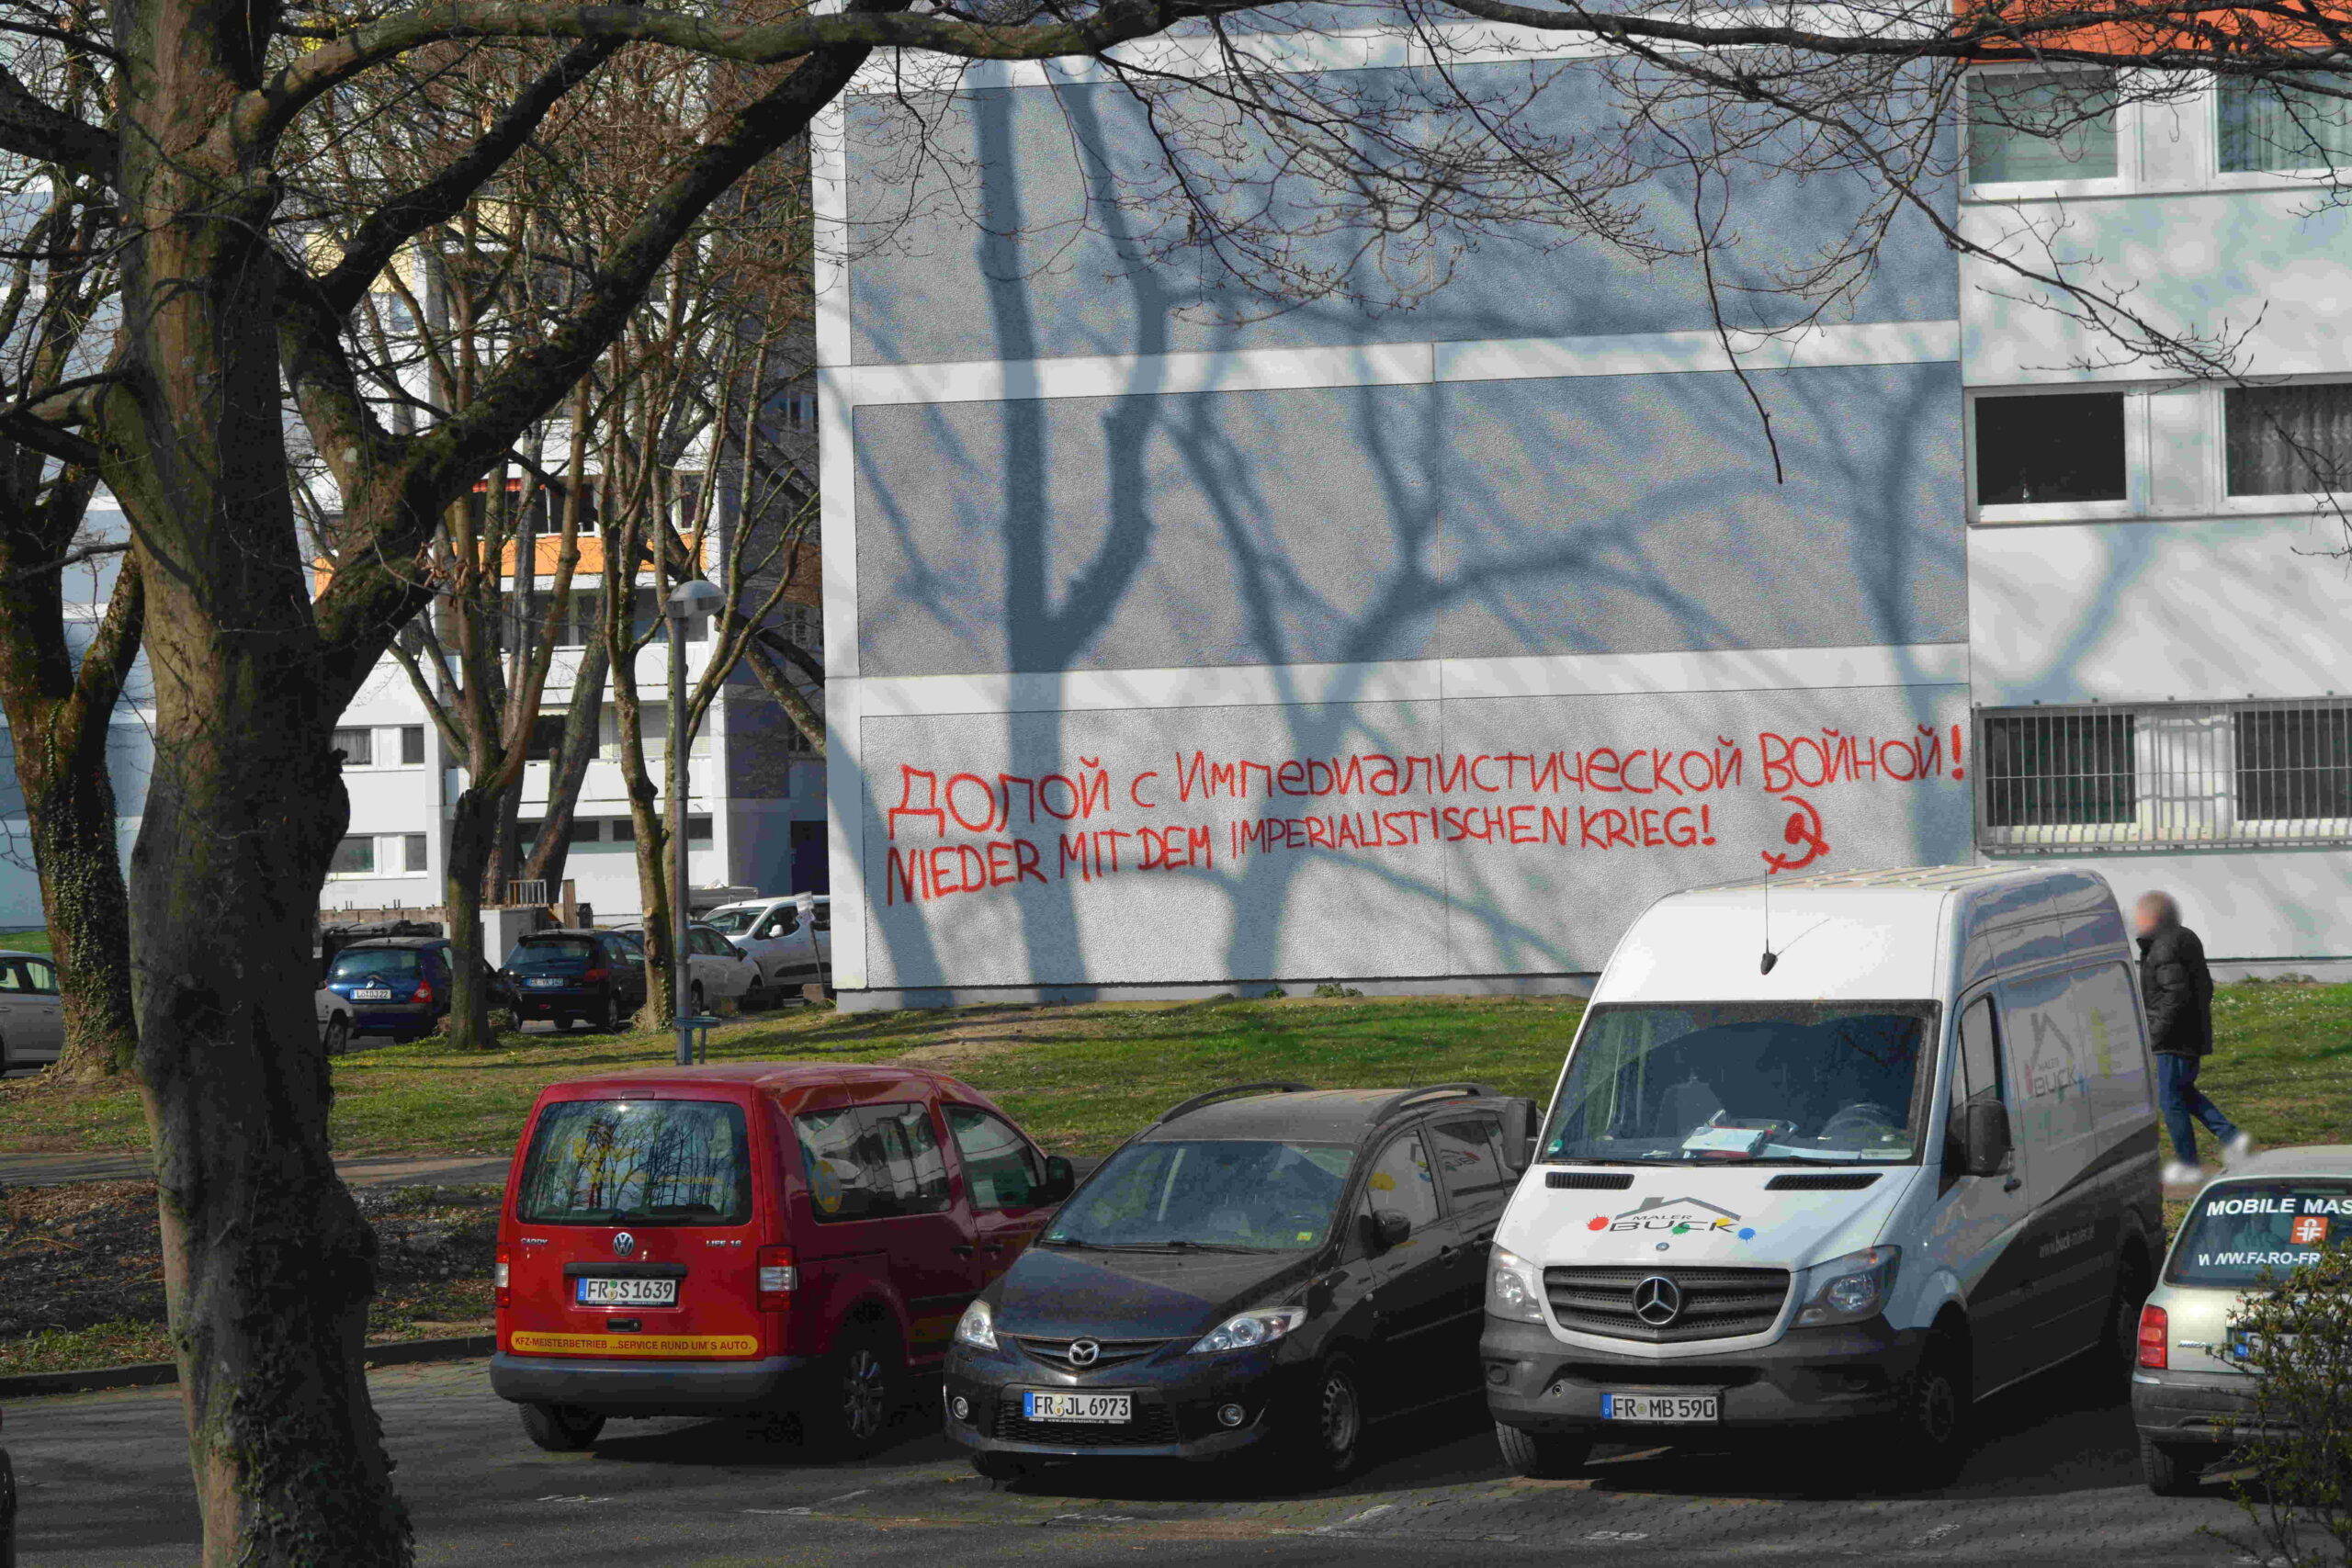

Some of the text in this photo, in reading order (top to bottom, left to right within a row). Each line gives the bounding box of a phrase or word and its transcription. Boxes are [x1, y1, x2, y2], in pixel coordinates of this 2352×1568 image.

[887, 803, 1717, 907] NIEDER MIT DEM IMPERIALISTISCHEN KRIEG!
[2207, 1198, 2297, 1217] MOBILE
[1610, 1220, 1739, 1233] BUCK
[588, 1280, 608, 1298] FR
[619, 1281, 629, 1298] S
[632, 1281, 673, 1299] 1639
[514, 1337, 608, 1348] KFZ-MEISTERBETRIEB
[661, 1341, 689, 1349] RUND
[719, 1341, 752, 1350] AUTO.
[1035, 1396, 1054, 1415] FR
[1066, 1397, 1085, 1416] JL
[1089, 1398, 1129, 1416] 6973
[1612, 1398, 1637, 1417] FR
[1649, 1399, 1675, 1418] MB
[1679, 1399, 1715, 1418] 590
